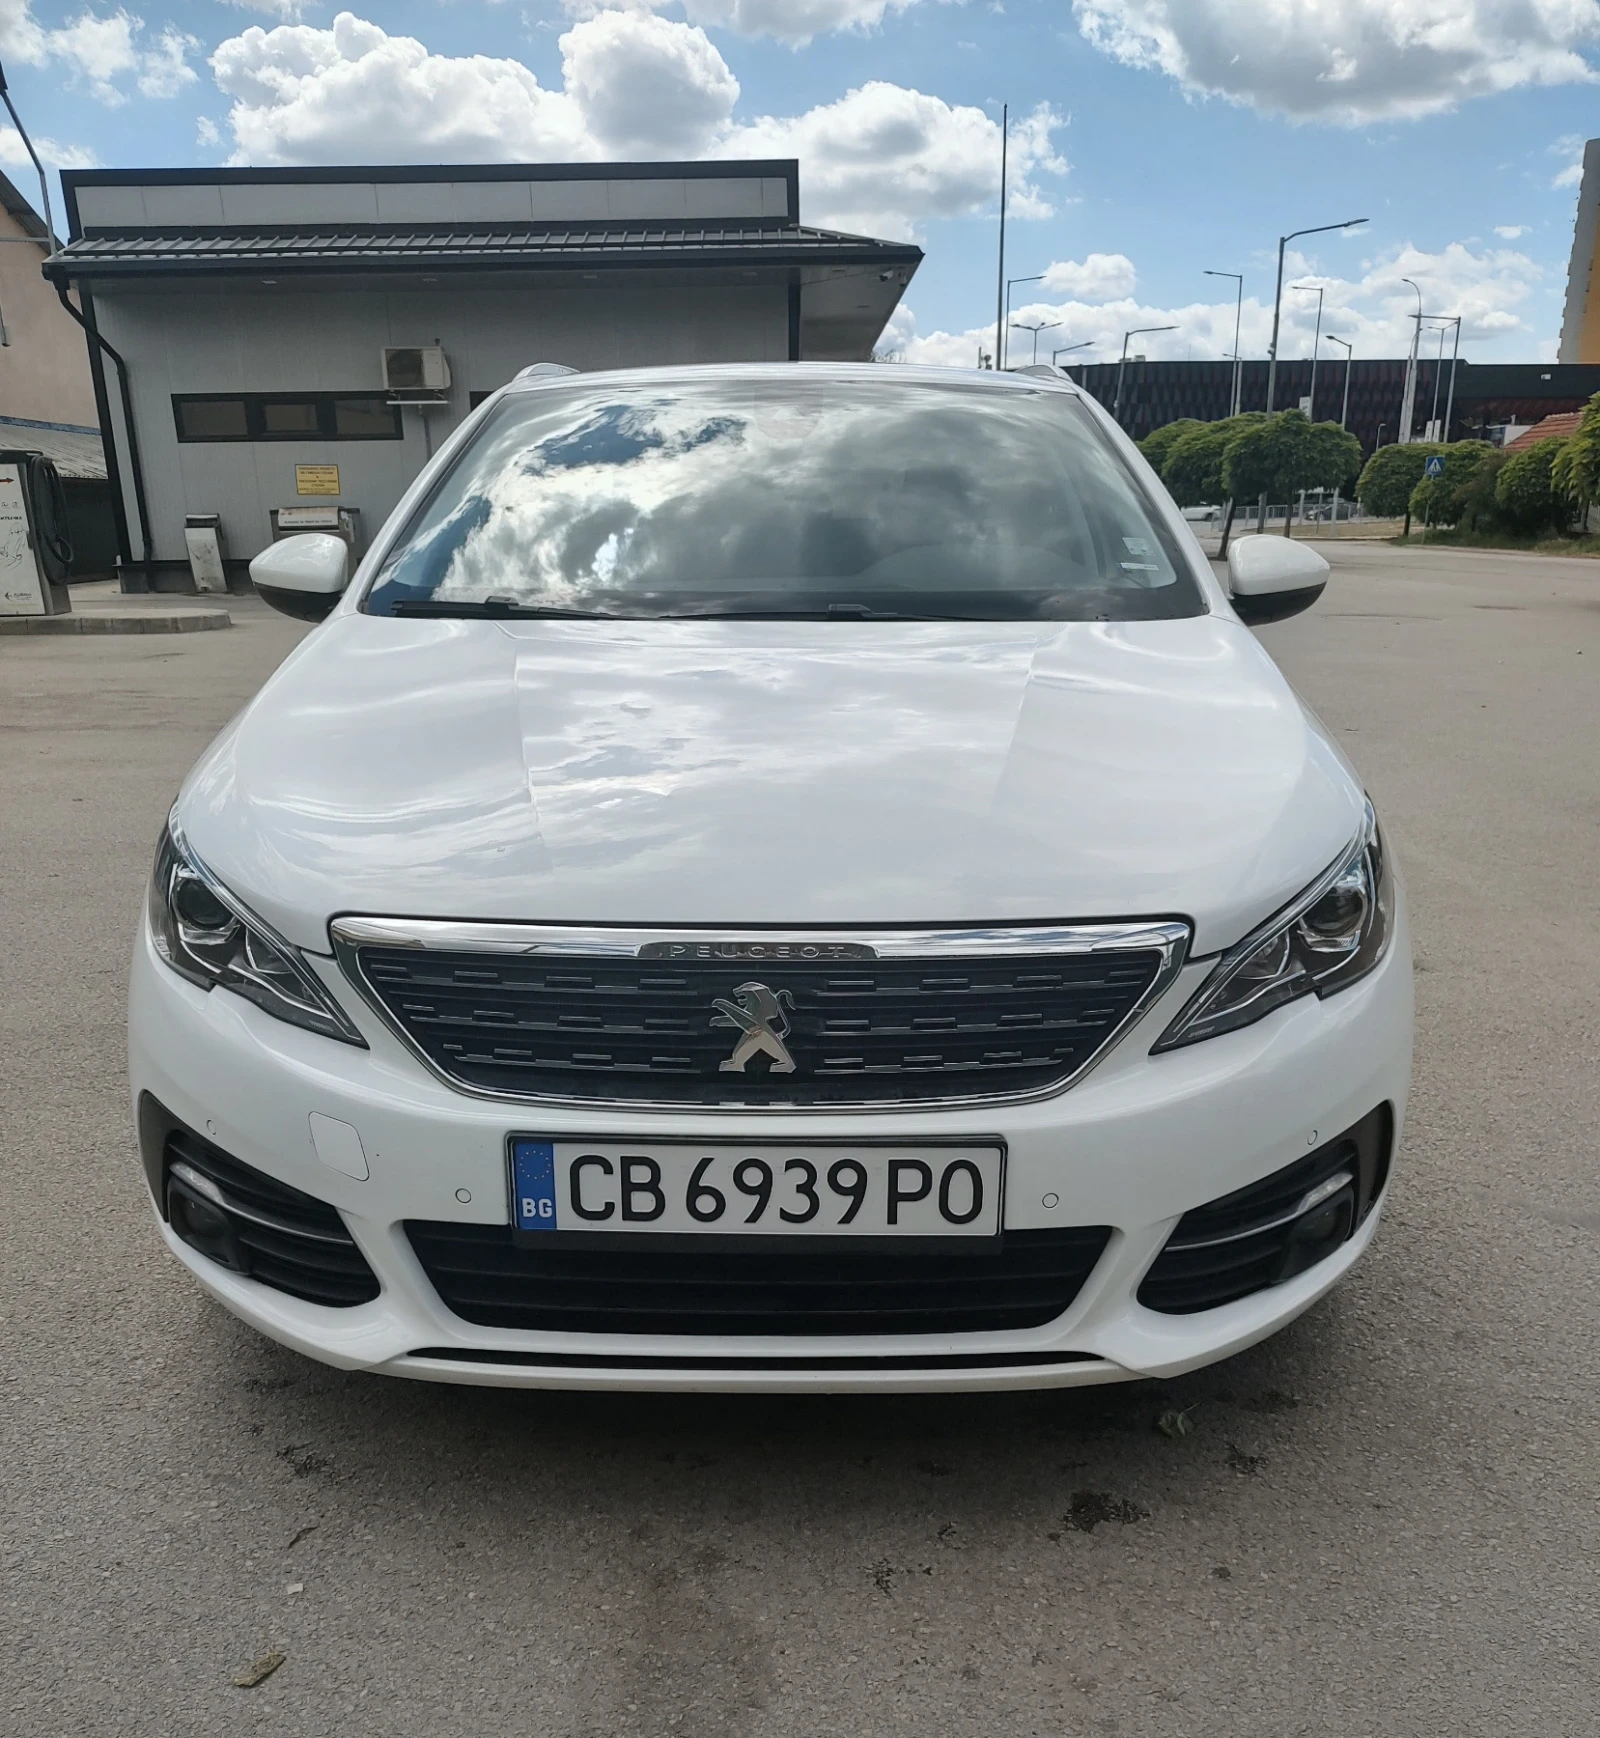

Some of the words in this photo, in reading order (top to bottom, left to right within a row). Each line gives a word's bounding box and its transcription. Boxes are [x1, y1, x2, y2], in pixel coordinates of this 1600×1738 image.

[670, 945, 845, 959] PEUGEOT
[569, 1154, 666, 1222] CB
[685, 1157, 869, 1225] 6939
[522, 1197, 553, 1219] BG
